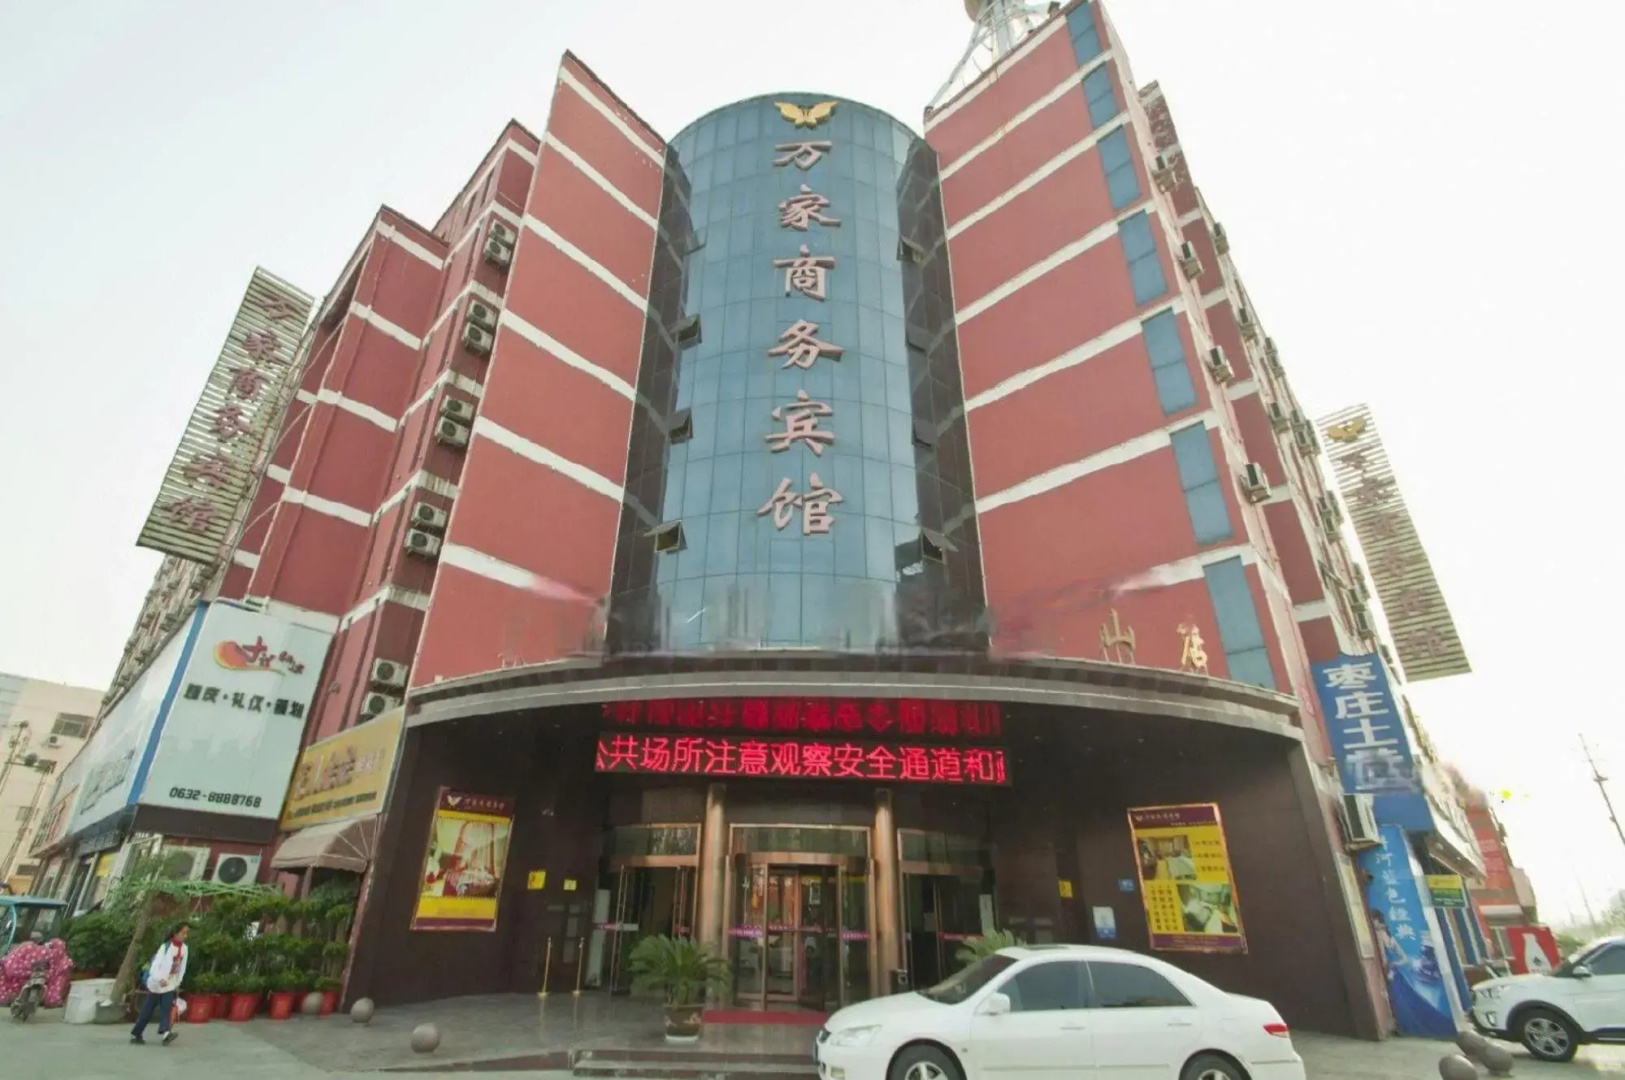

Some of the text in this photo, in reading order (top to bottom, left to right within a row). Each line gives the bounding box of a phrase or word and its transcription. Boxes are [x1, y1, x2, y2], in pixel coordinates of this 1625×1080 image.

[756, 139, 844, 535] 万家商务宾馆
[595, 735, 1006, 784] 共场所注意观察安全通道和
[168, 787, 262, 808] 0632-8888768
